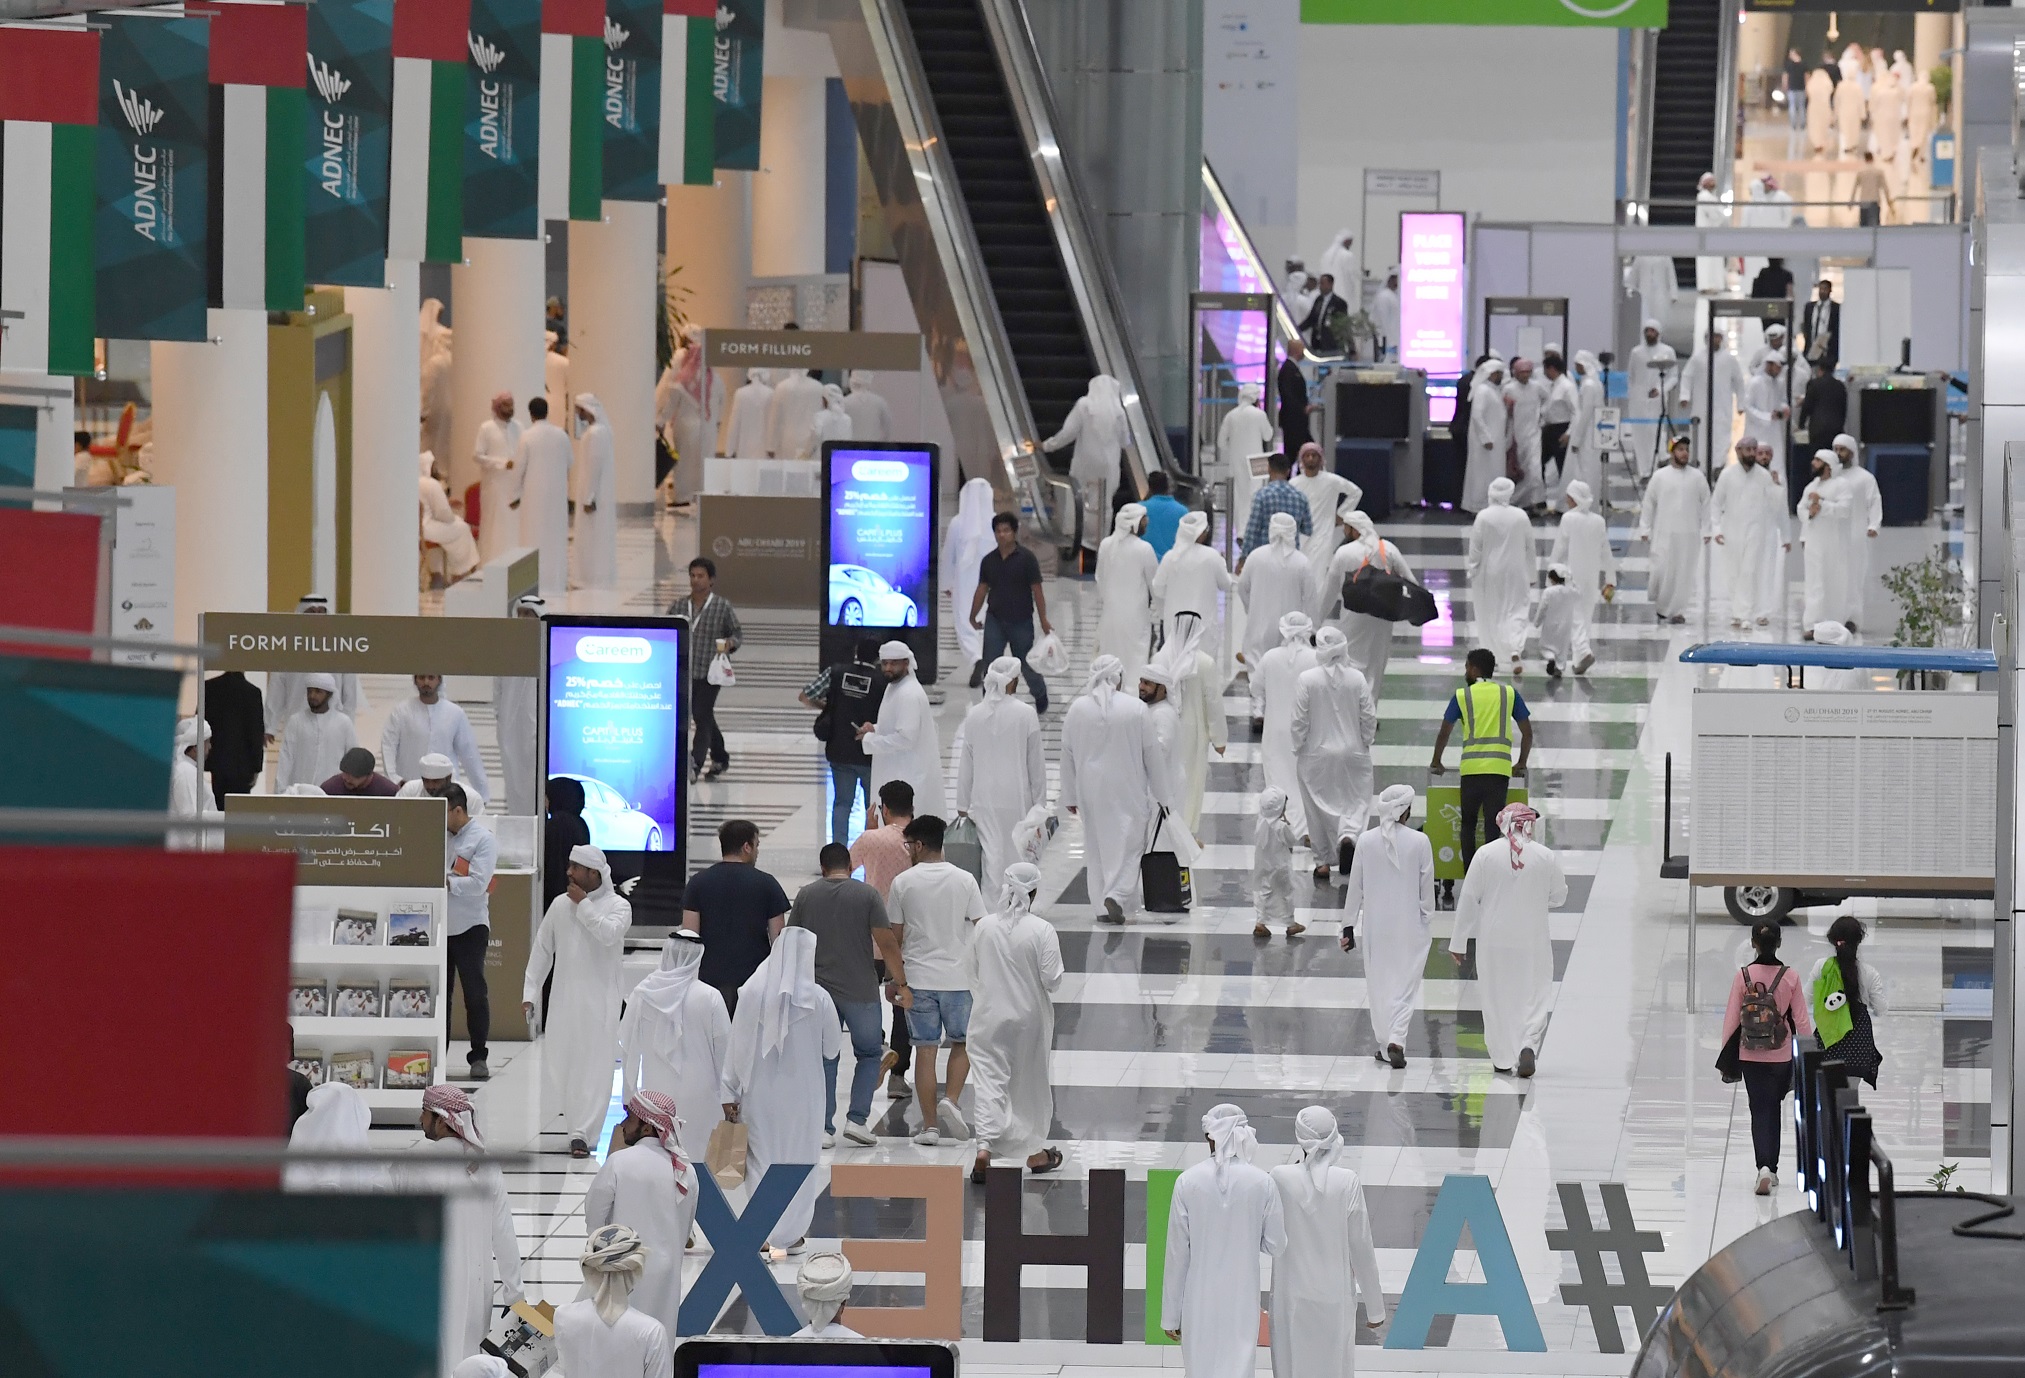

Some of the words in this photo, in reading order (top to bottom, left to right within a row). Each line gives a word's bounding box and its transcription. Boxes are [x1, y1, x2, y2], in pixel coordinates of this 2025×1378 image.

[606, 56, 624, 129] ADNEC
[713, 36, 730, 103] ADNEC
[480, 80, 500, 159] ADNEC
[322, 110, 344, 198] ADNEC
[134, 144, 157, 241] ADNEC
[720, 342, 759, 354] FORM
[762, 343, 811, 356] FILLING
[229, 634, 287, 651] FORM
[294, 636, 370, 653] FILLING
[584, 643, 644, 656] Careem
[622, 726, 643, 737] PLUS
